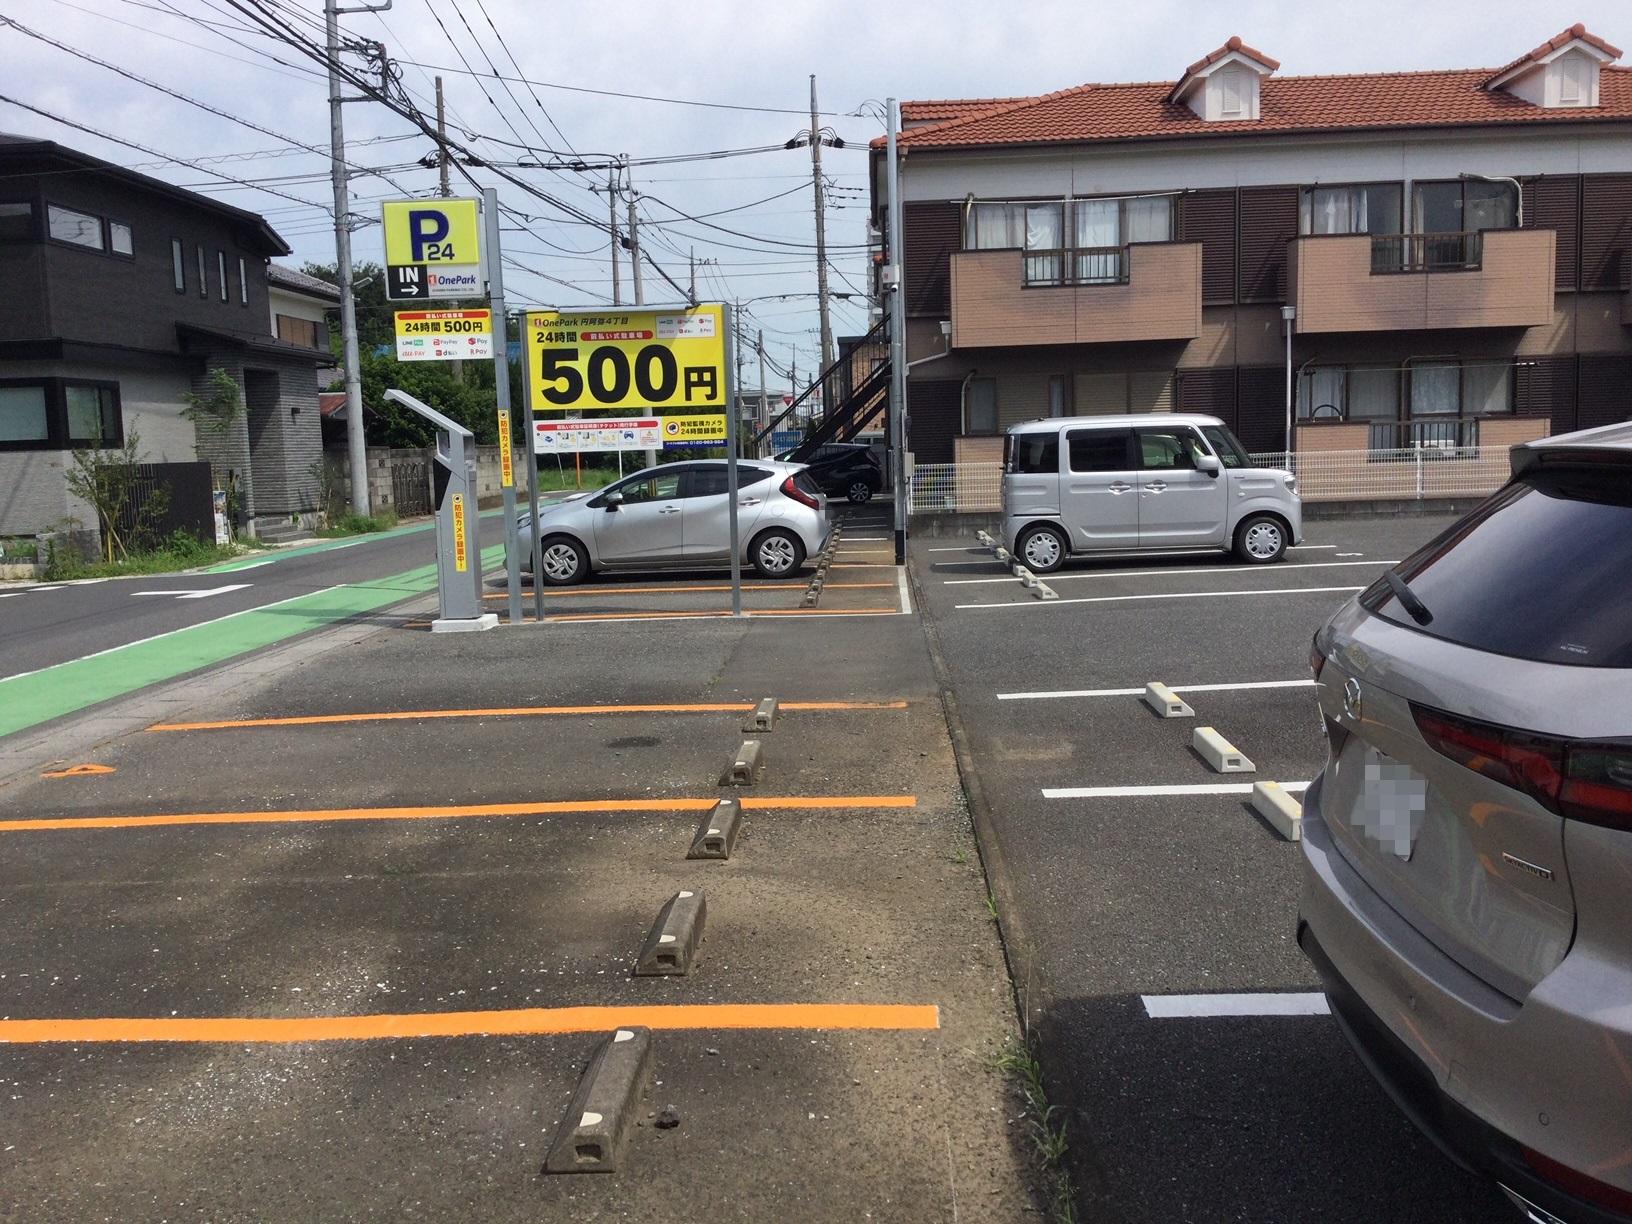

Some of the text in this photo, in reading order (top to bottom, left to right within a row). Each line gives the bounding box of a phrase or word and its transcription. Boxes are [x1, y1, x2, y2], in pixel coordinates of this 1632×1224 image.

[409, 210, 449, 262] P
[427, 243, 455, 261] 24
[399, 267, 419, 283] IN
[438, 274, 476, 285] OnePark
[405, 321, 483, 332] 24時間 500円
[542, 318, 578, 327] OnePark
[536, 331, 577, 343] 24時間
[541, 344, 718, 405] 500円
[680, 427, 724, 435] 24時間録画中
